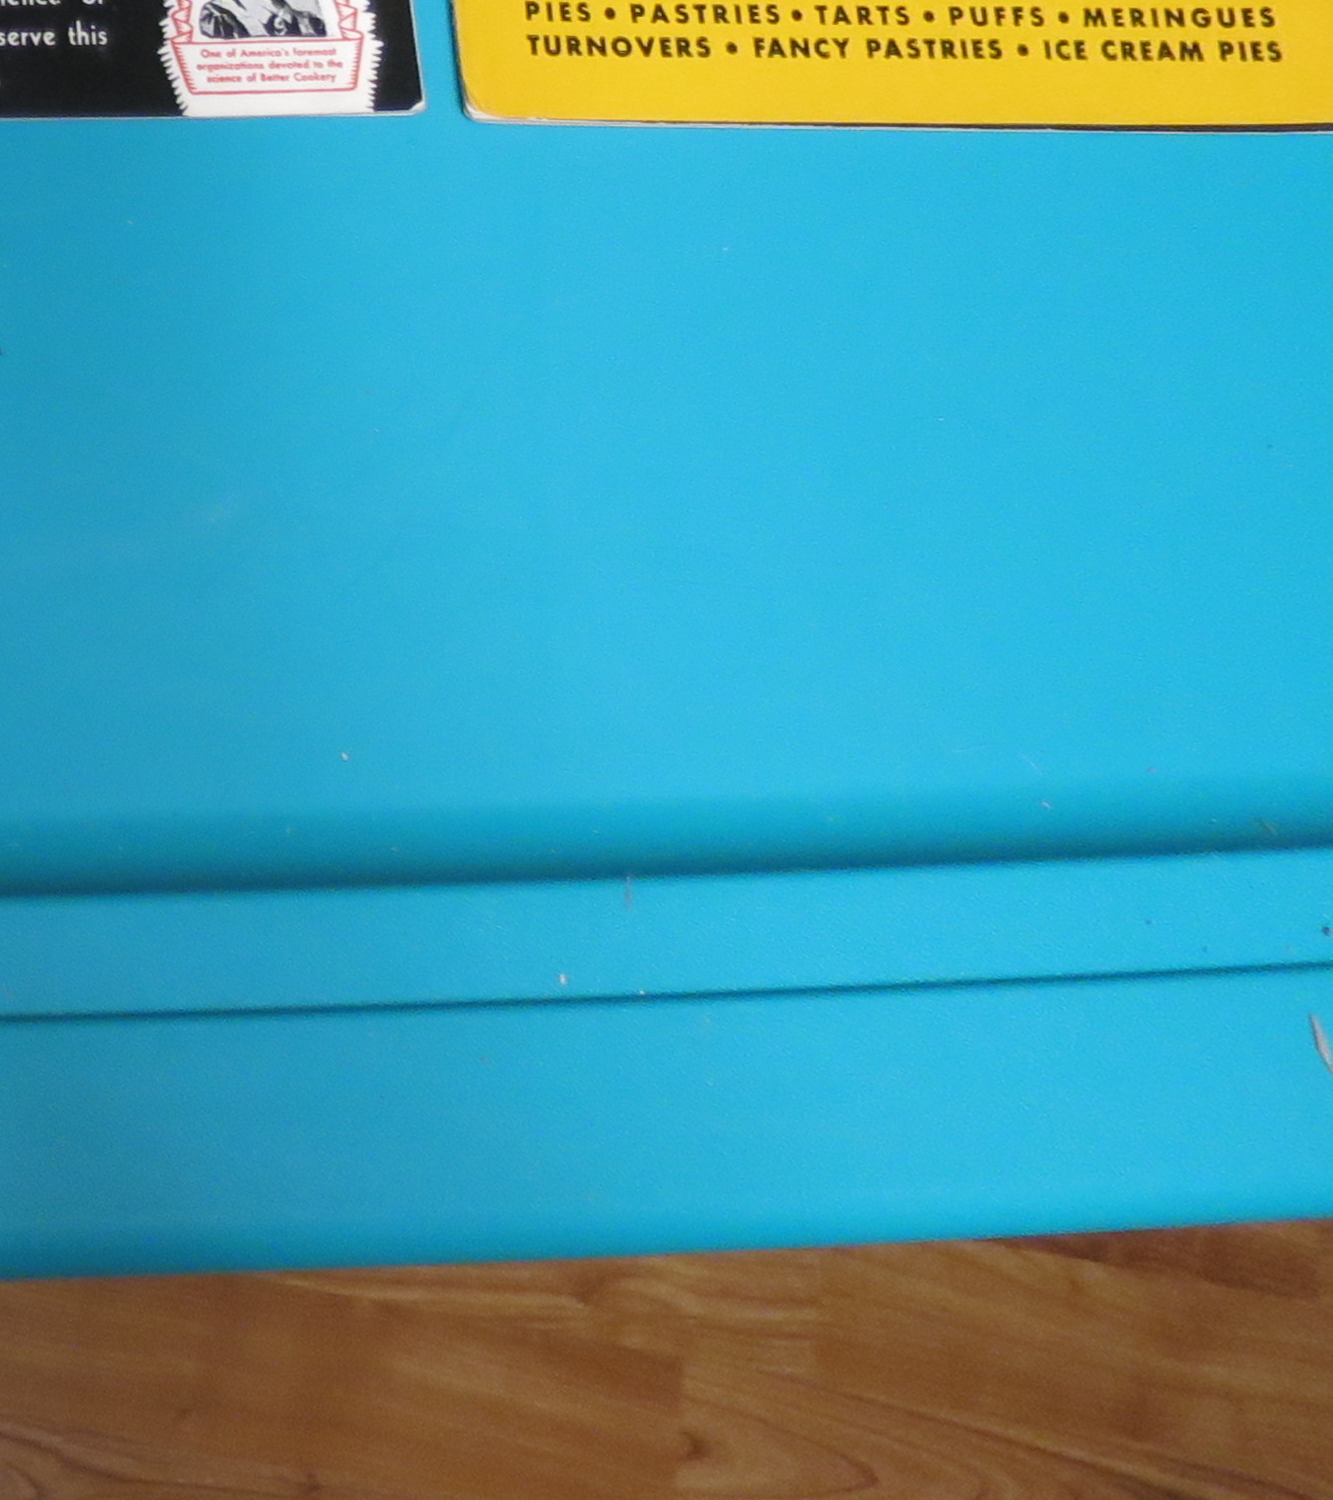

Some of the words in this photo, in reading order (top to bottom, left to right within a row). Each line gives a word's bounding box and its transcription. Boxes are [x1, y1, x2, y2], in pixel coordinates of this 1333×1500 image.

[524, 0, 592, 23] PIES
[629, 3, 781, 26] PASTRIES
[813, 4, 912, 27] TARTS
[948, 6, 1045, 28] PUFFS
[1081, 6, 1277, 29] MERINGUES
[67, 20, 110, 47] this
[525, 33, 713, 59] TURNOVERS
[752, 36, 851, 60] FANCY
[864, 37, 1003, 61] PASTRIES
[1043, 39, 1090, 62] ICE
[1100, 40, 1205, 62] CREAM
[1217, 40, 1284, 63] PIES
